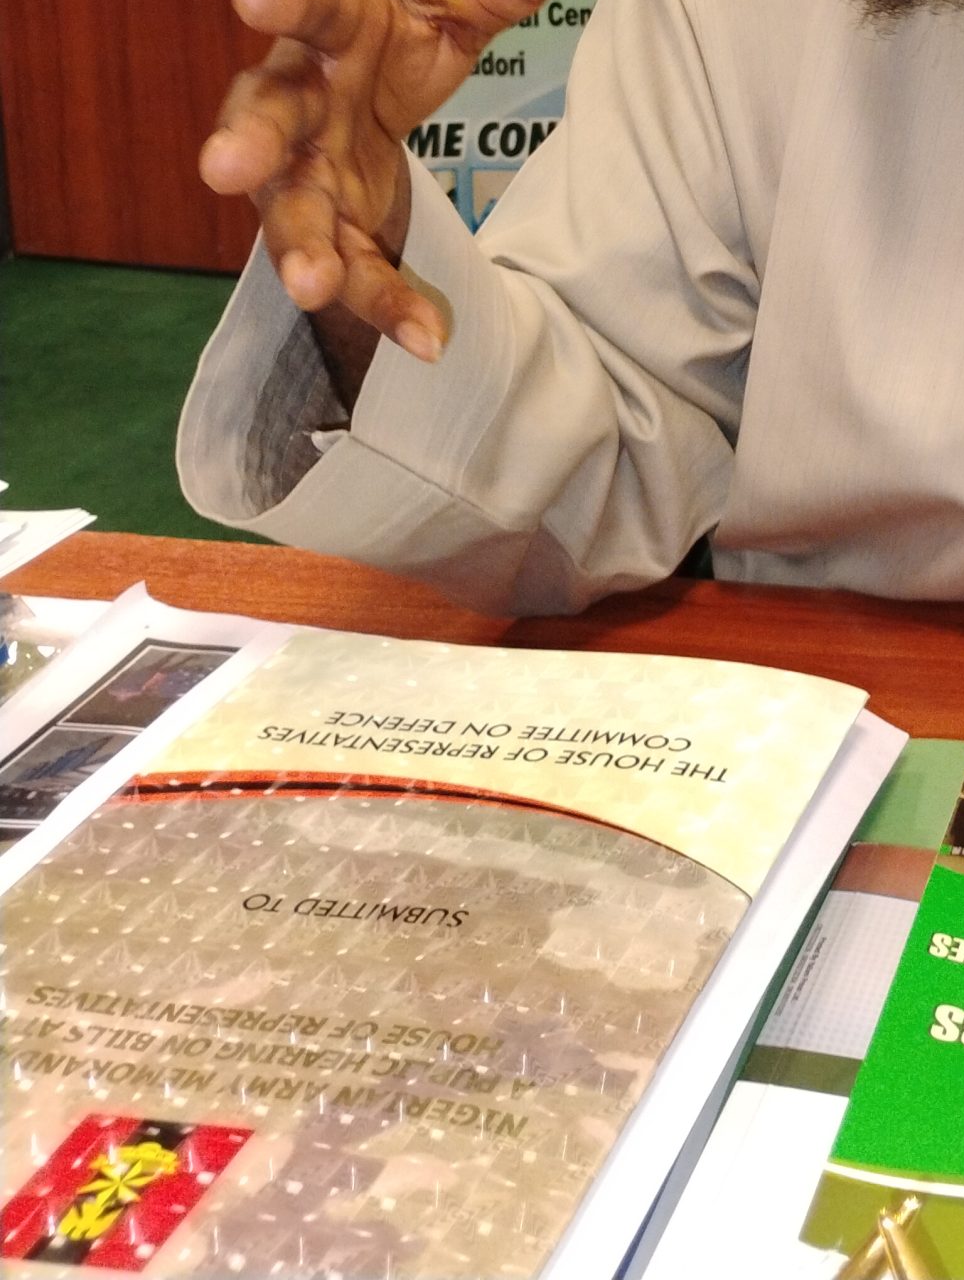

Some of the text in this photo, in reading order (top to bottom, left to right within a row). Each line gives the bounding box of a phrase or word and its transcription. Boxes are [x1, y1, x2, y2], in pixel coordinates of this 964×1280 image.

[548, 2, 592, 27] Cen
[407, 122, 465, 158] ME
[325, 710, 692, 752] COMMITTEE ON DEFENCE
[257, 725, 728, 784] THE HOUSE OF REPRESENTATIVES
[242, 894, 469, 928] SUBMITTED TO
[27, 984, 506, 1055] HOUSE OF REPRESENTATIVES
[63, 1024, 156, 1053] BILLS
[164, 1037, 212, 1059] ON
[216, 1039, 367, 1074] HEARING
[218, 1074, 324, 1106] ARMY
[335, 1086, 529, 1139] NIGERIAN
